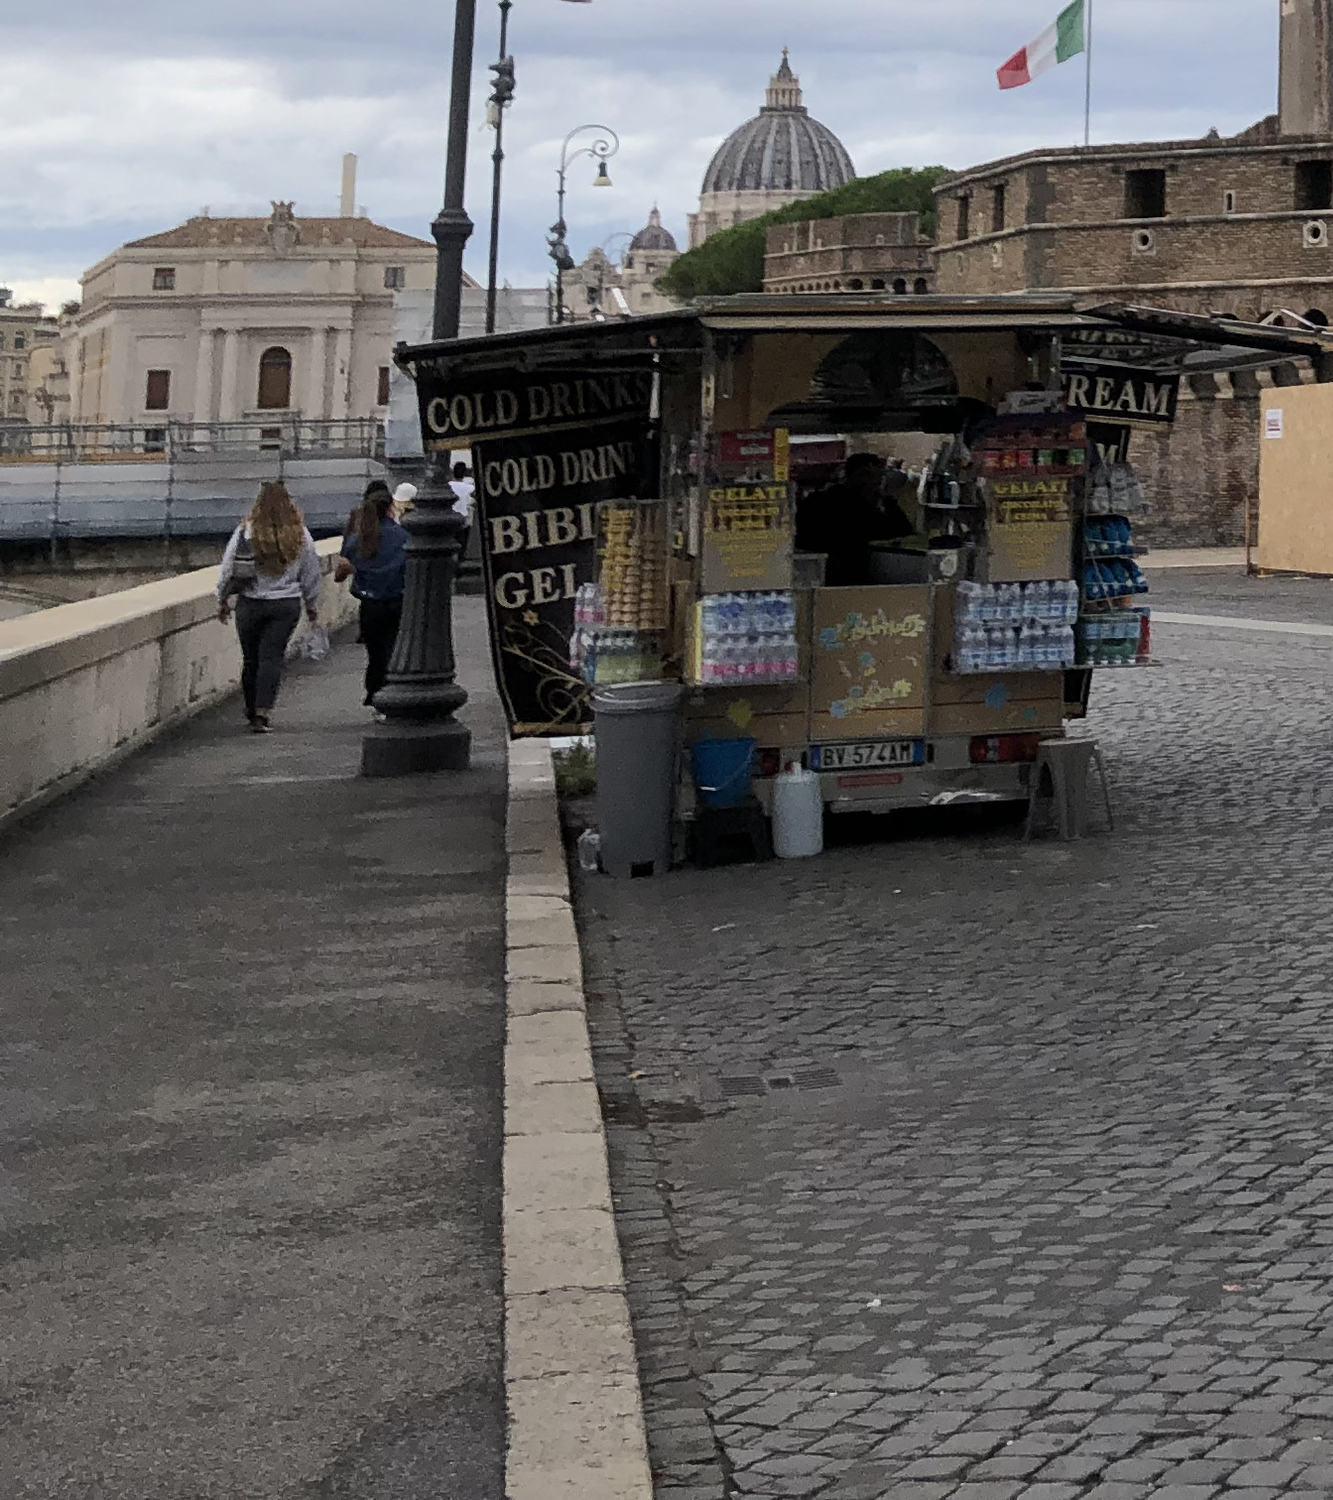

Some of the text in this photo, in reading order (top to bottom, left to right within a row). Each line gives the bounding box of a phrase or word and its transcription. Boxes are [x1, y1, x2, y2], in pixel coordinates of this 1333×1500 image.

[427, 371, 649, 433] COLD DRINKS
[1062, 373, 1173, 416] REAM
[485, 453, 556, 497] COLD
[709, 485, 788, 501] GELATI
[993, 480, 1068, 495] GELATI
[488, 502, 598, 555] BIBI
[823, 746, 848, 767] BV
